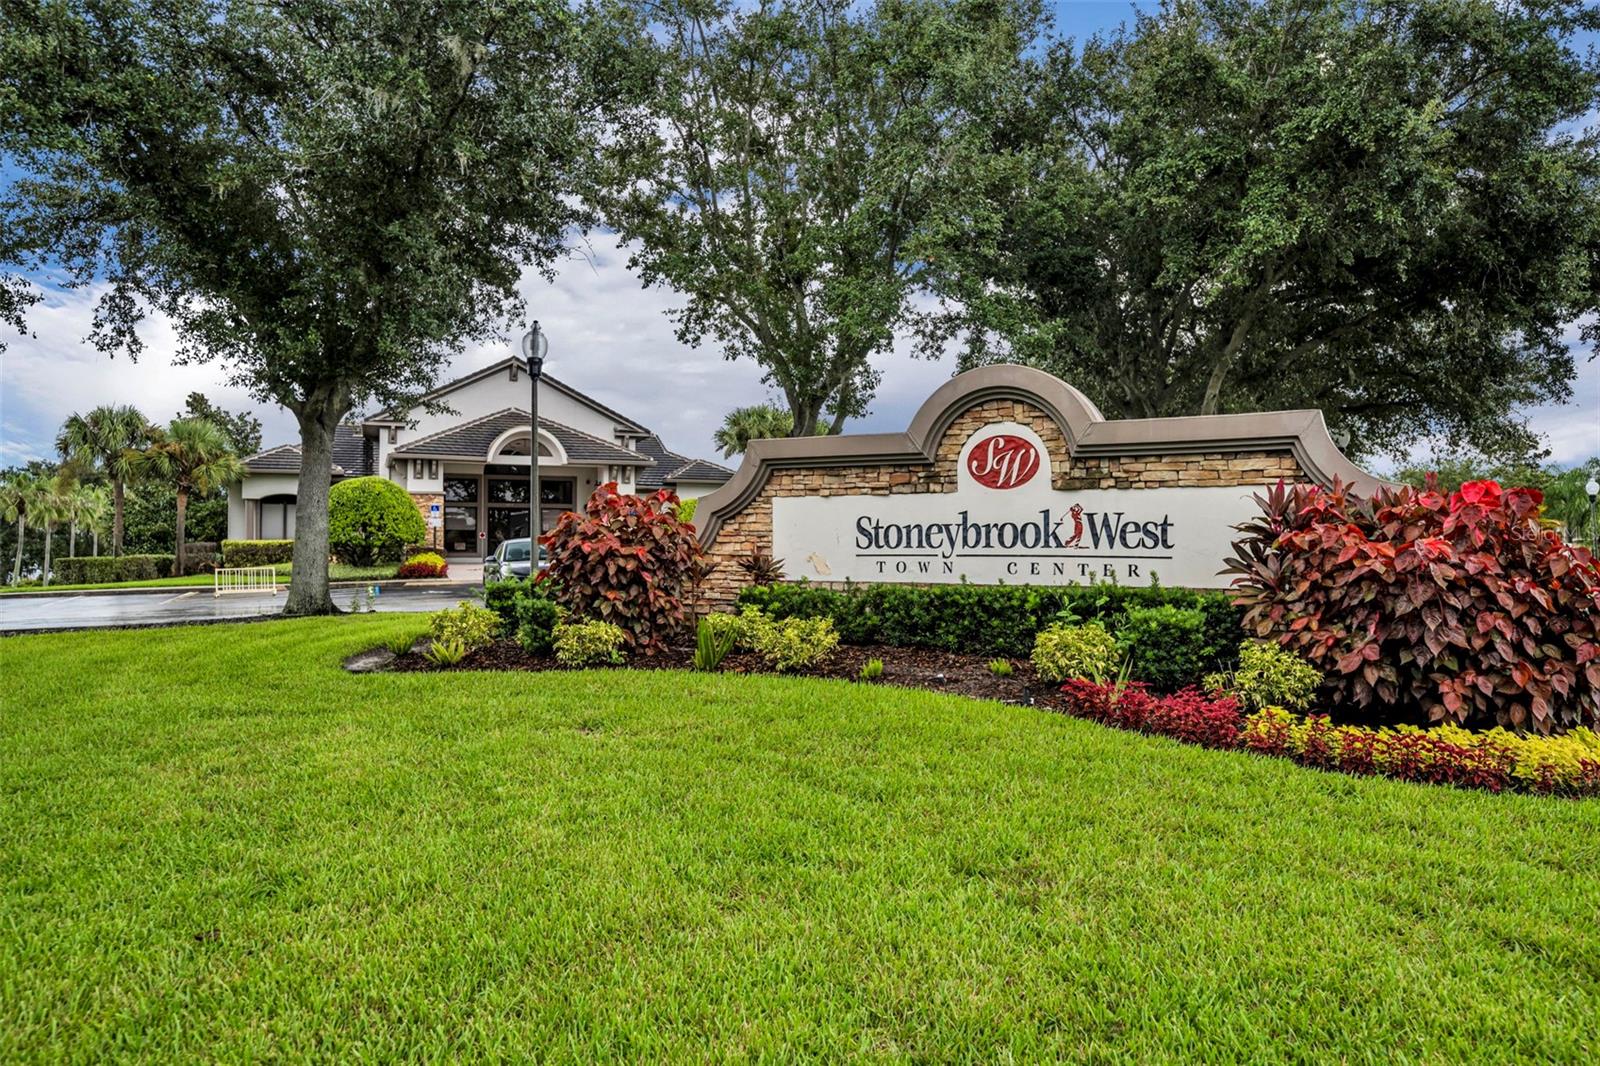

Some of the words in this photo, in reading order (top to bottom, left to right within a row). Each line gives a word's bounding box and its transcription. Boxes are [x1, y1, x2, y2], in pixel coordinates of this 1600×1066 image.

[972, 437, 1036, 487] SW
[855, 509, 1066, 559] Stoneybrook
[1083, 511, 1176, 550] West
[876, 561, 954, 575] TOWN
[1006, 561, 1141, 578] CENTER
